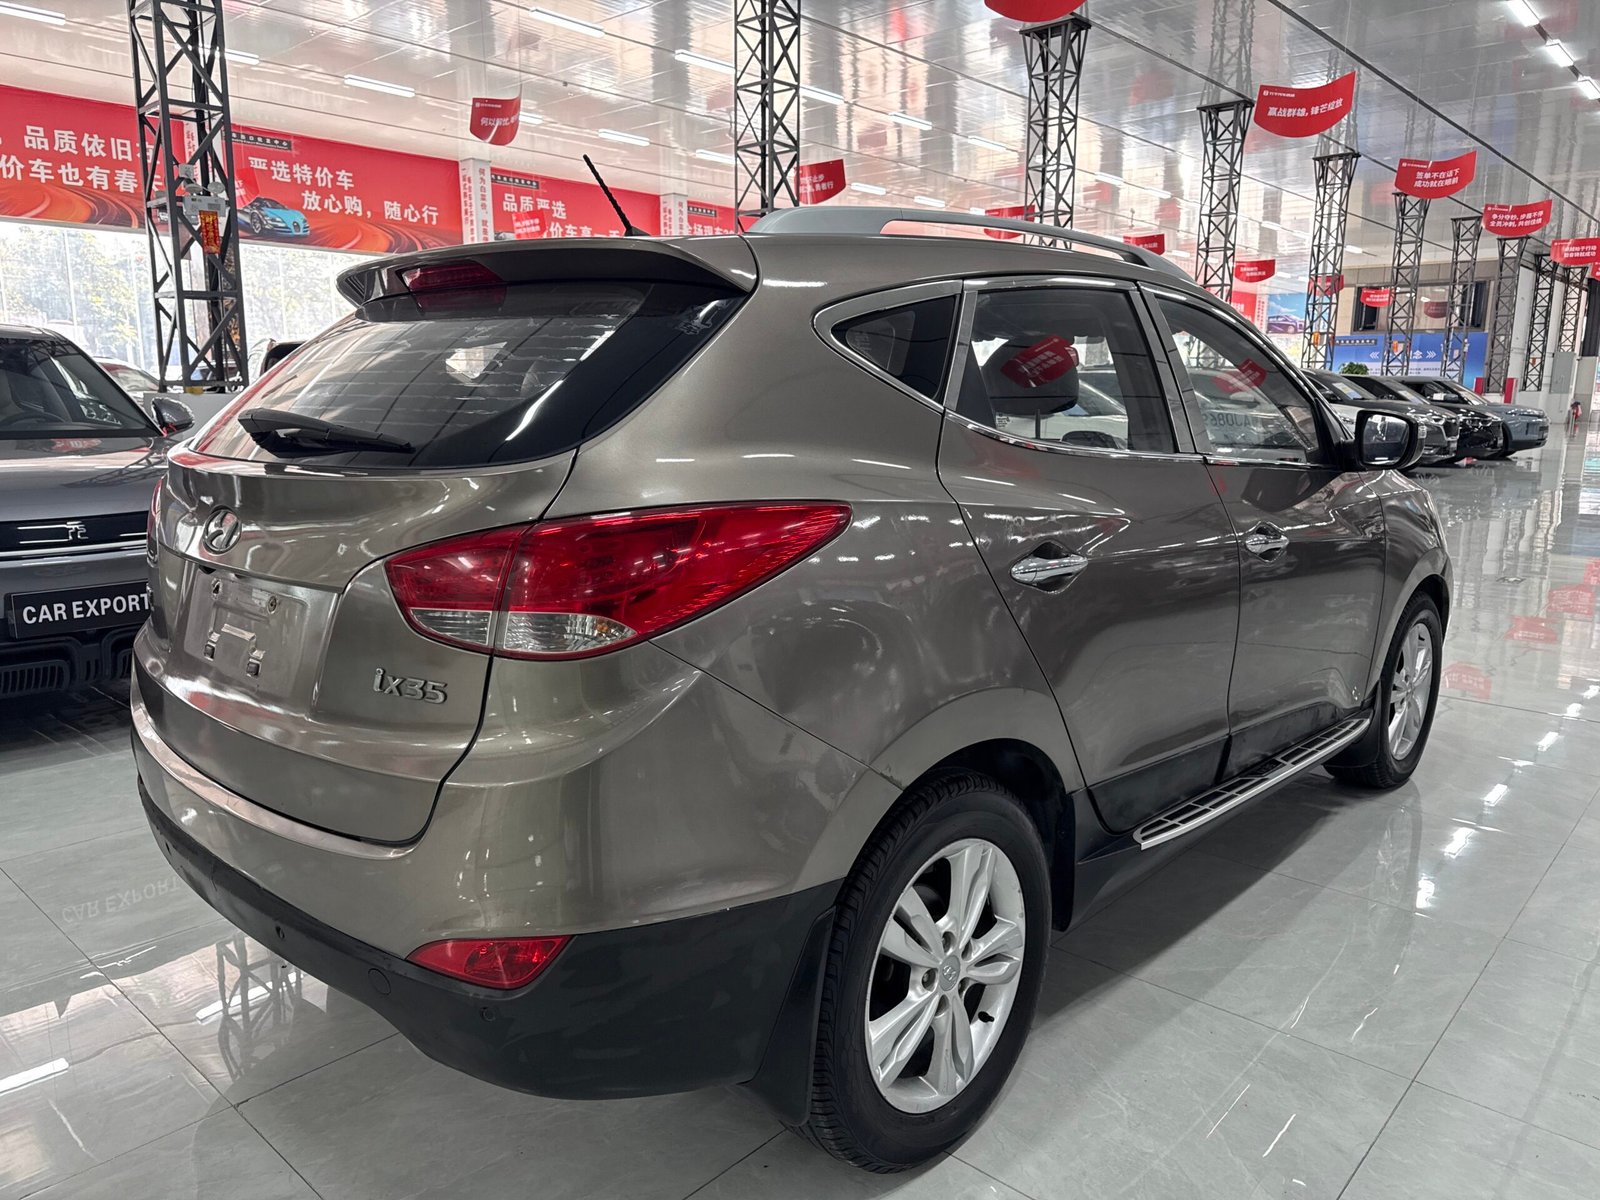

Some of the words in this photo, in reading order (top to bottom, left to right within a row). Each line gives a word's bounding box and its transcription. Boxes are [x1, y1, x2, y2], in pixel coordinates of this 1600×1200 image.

[301, 190, 439, 226] 放心购，随心行
[22, 603, 68, 625] CAR
[72, 593, 149, 620] EXPORT
[372, 667, 448, 705] ix35
